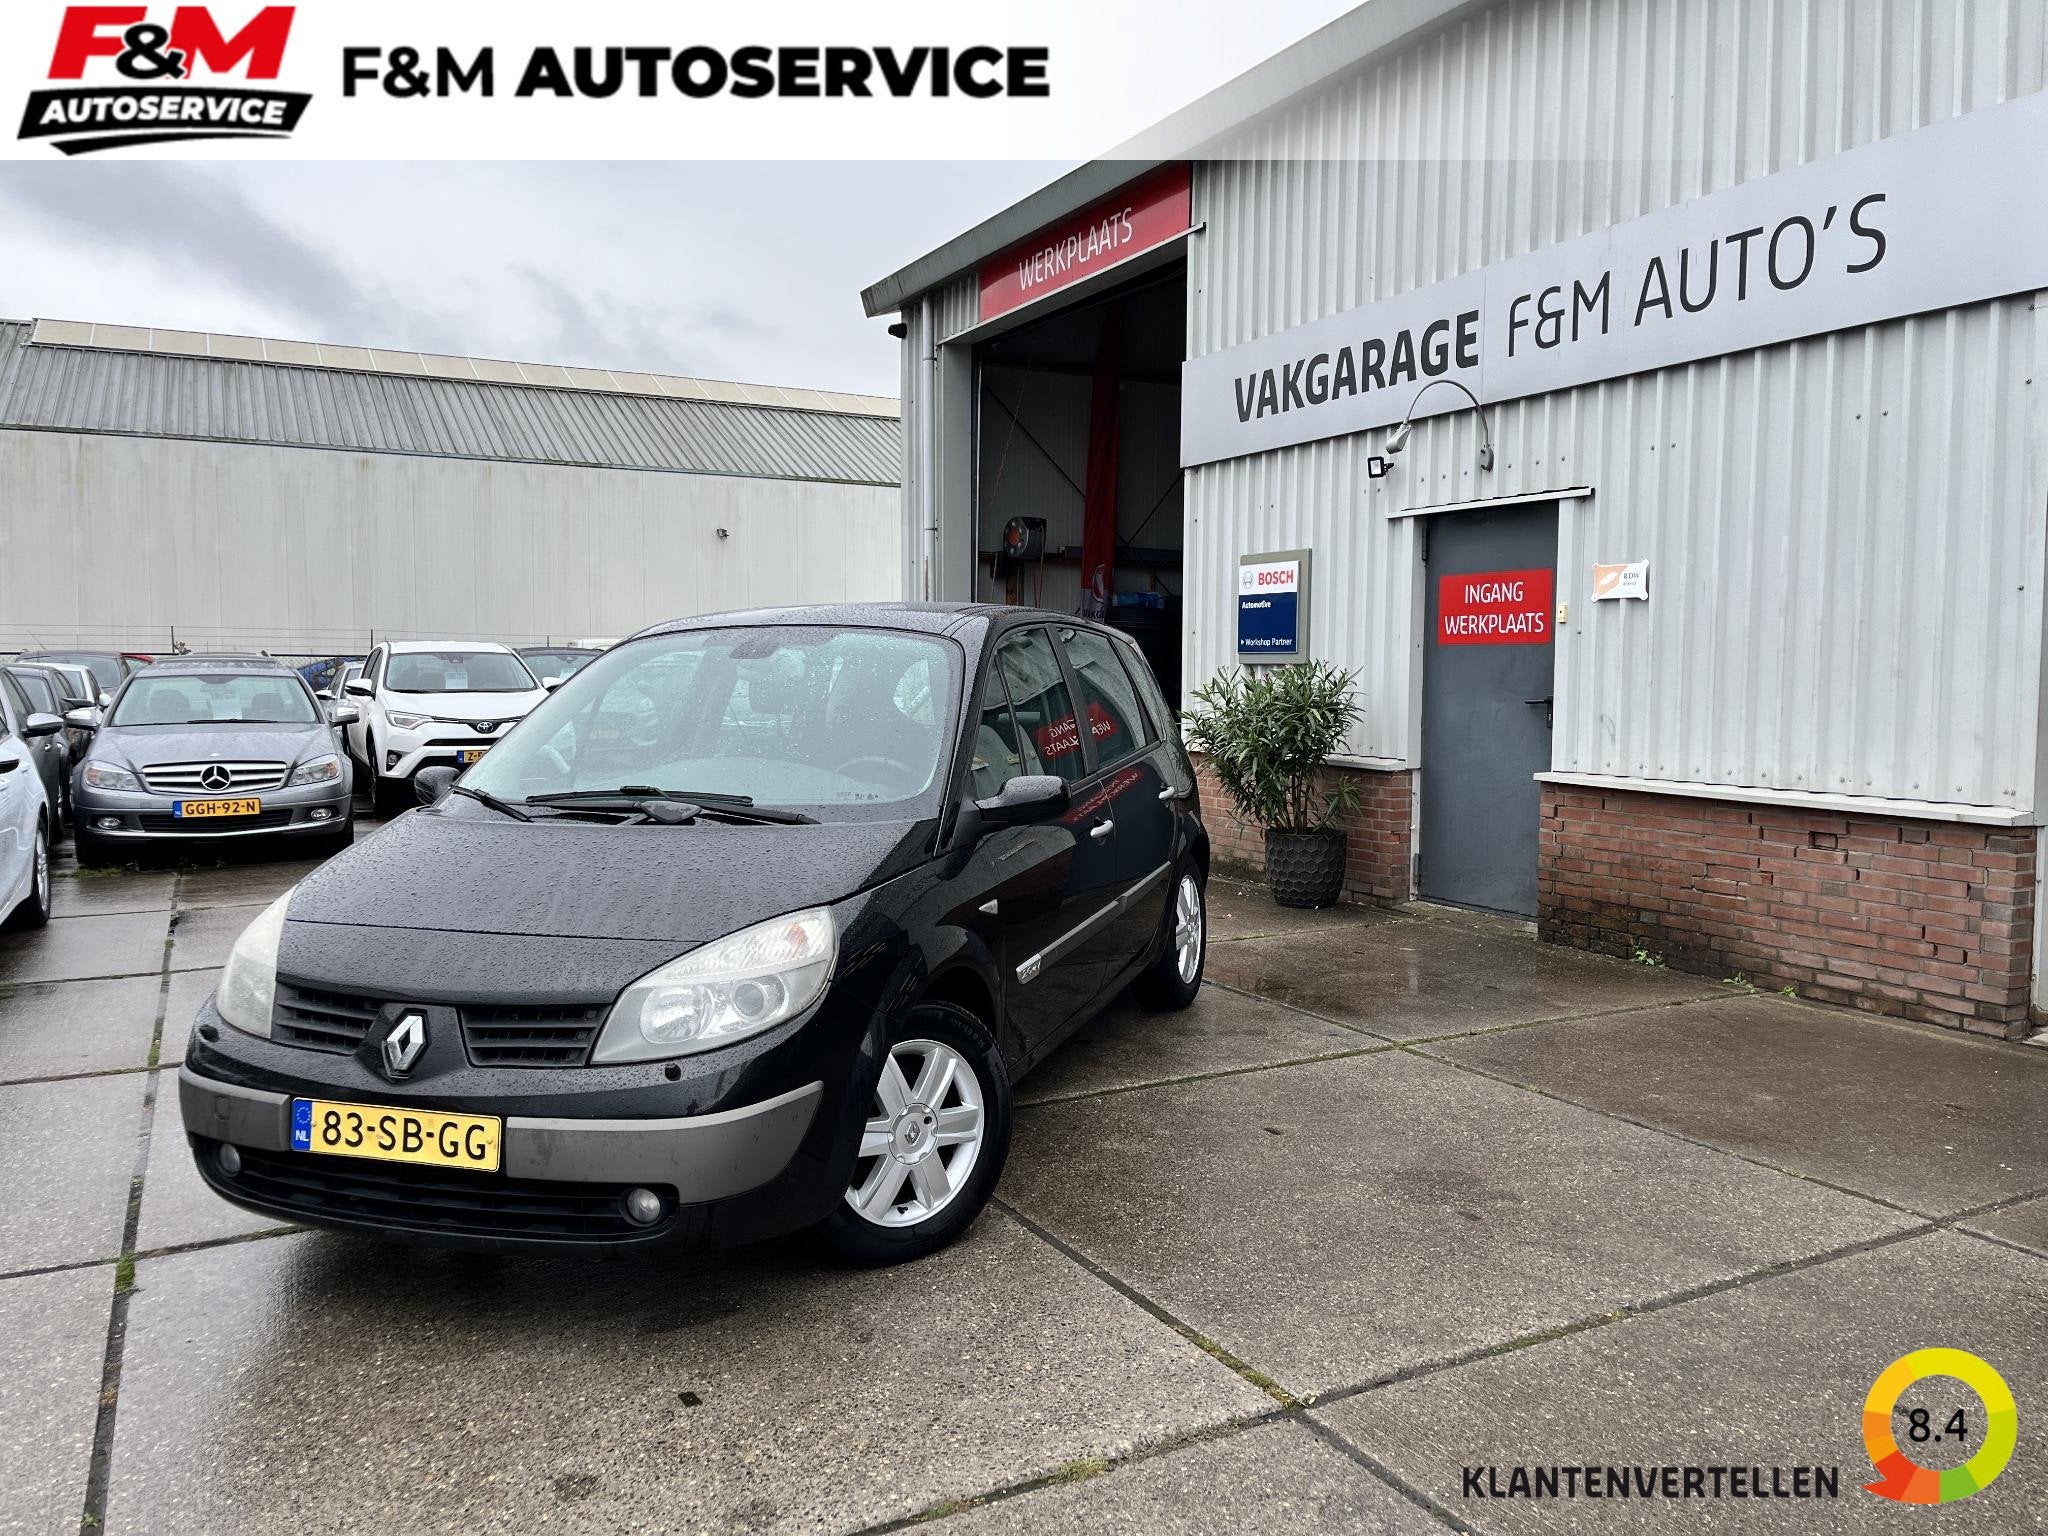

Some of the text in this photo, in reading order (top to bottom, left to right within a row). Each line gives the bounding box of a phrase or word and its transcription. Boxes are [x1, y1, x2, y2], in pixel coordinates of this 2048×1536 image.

[1019, 207, 1132, 290] WERKPLAATS
[1234, 193, 1886, 422] VAKGARAGE F&M AUTO'S
[1257, 570, 1294, 586] BOSCH
[1464, 582, 1524, 604] INGANG
[1241, 600, 1271, 609] Automotive
[1444, 612, 1544, 635] WERKPLAATS
[1245, 637, 1293, 647] Workshop Partner
[186, 801, 255, 815] GGH-92-N
[295, 1130, 309, 1142] NL
[322, 1110, 486, 1160] 83-SB-GG
